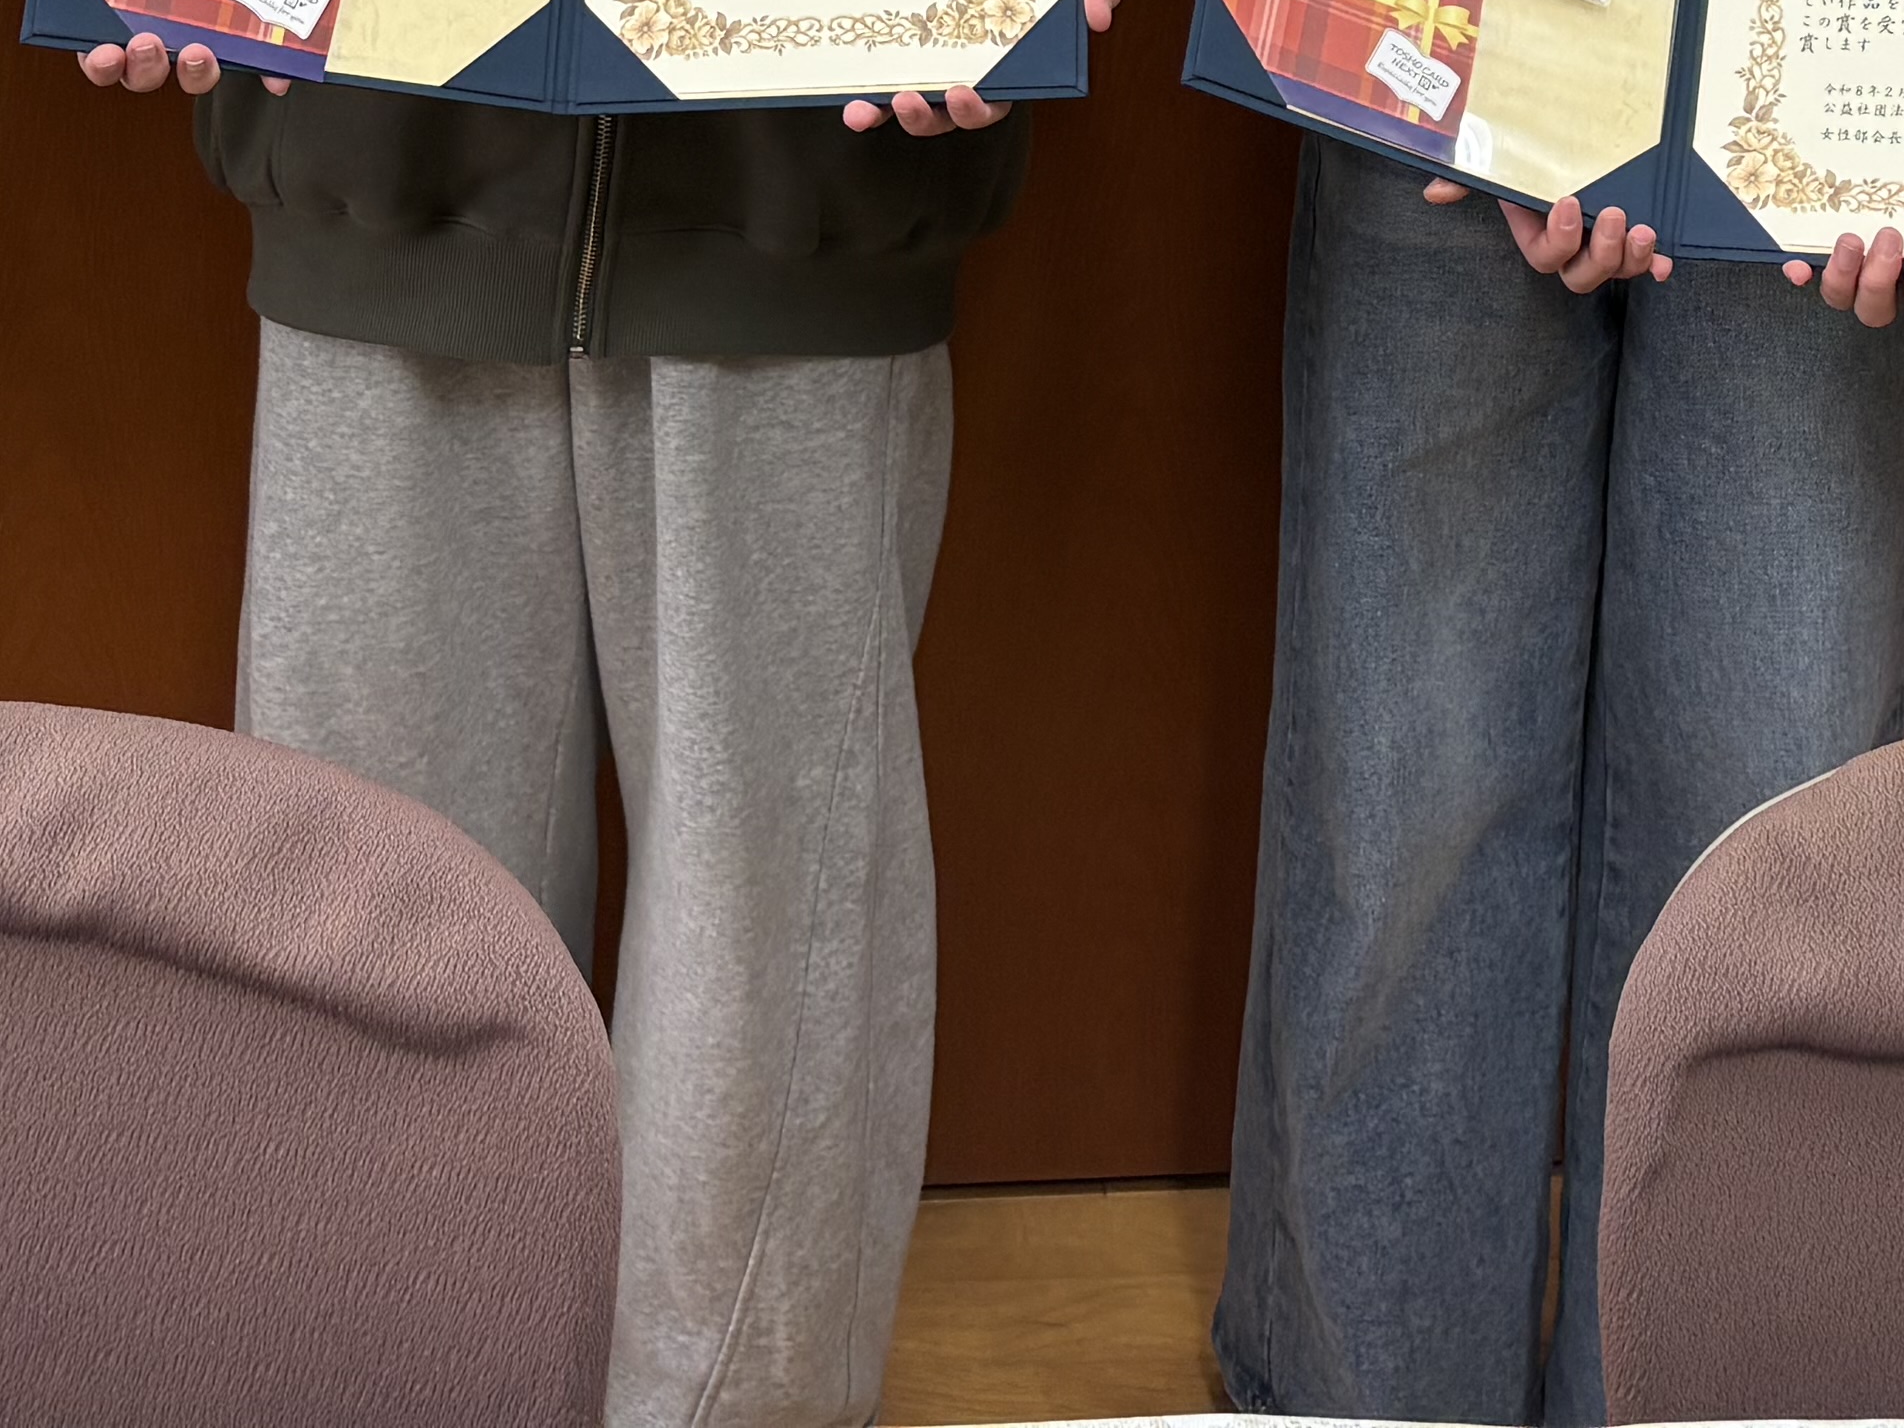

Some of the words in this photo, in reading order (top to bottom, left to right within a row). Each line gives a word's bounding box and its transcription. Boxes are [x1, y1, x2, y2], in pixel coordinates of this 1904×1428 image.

[1799, 32, 1871, 55] 賞します
[1820, 127, 1903, 147] 女性部会長
